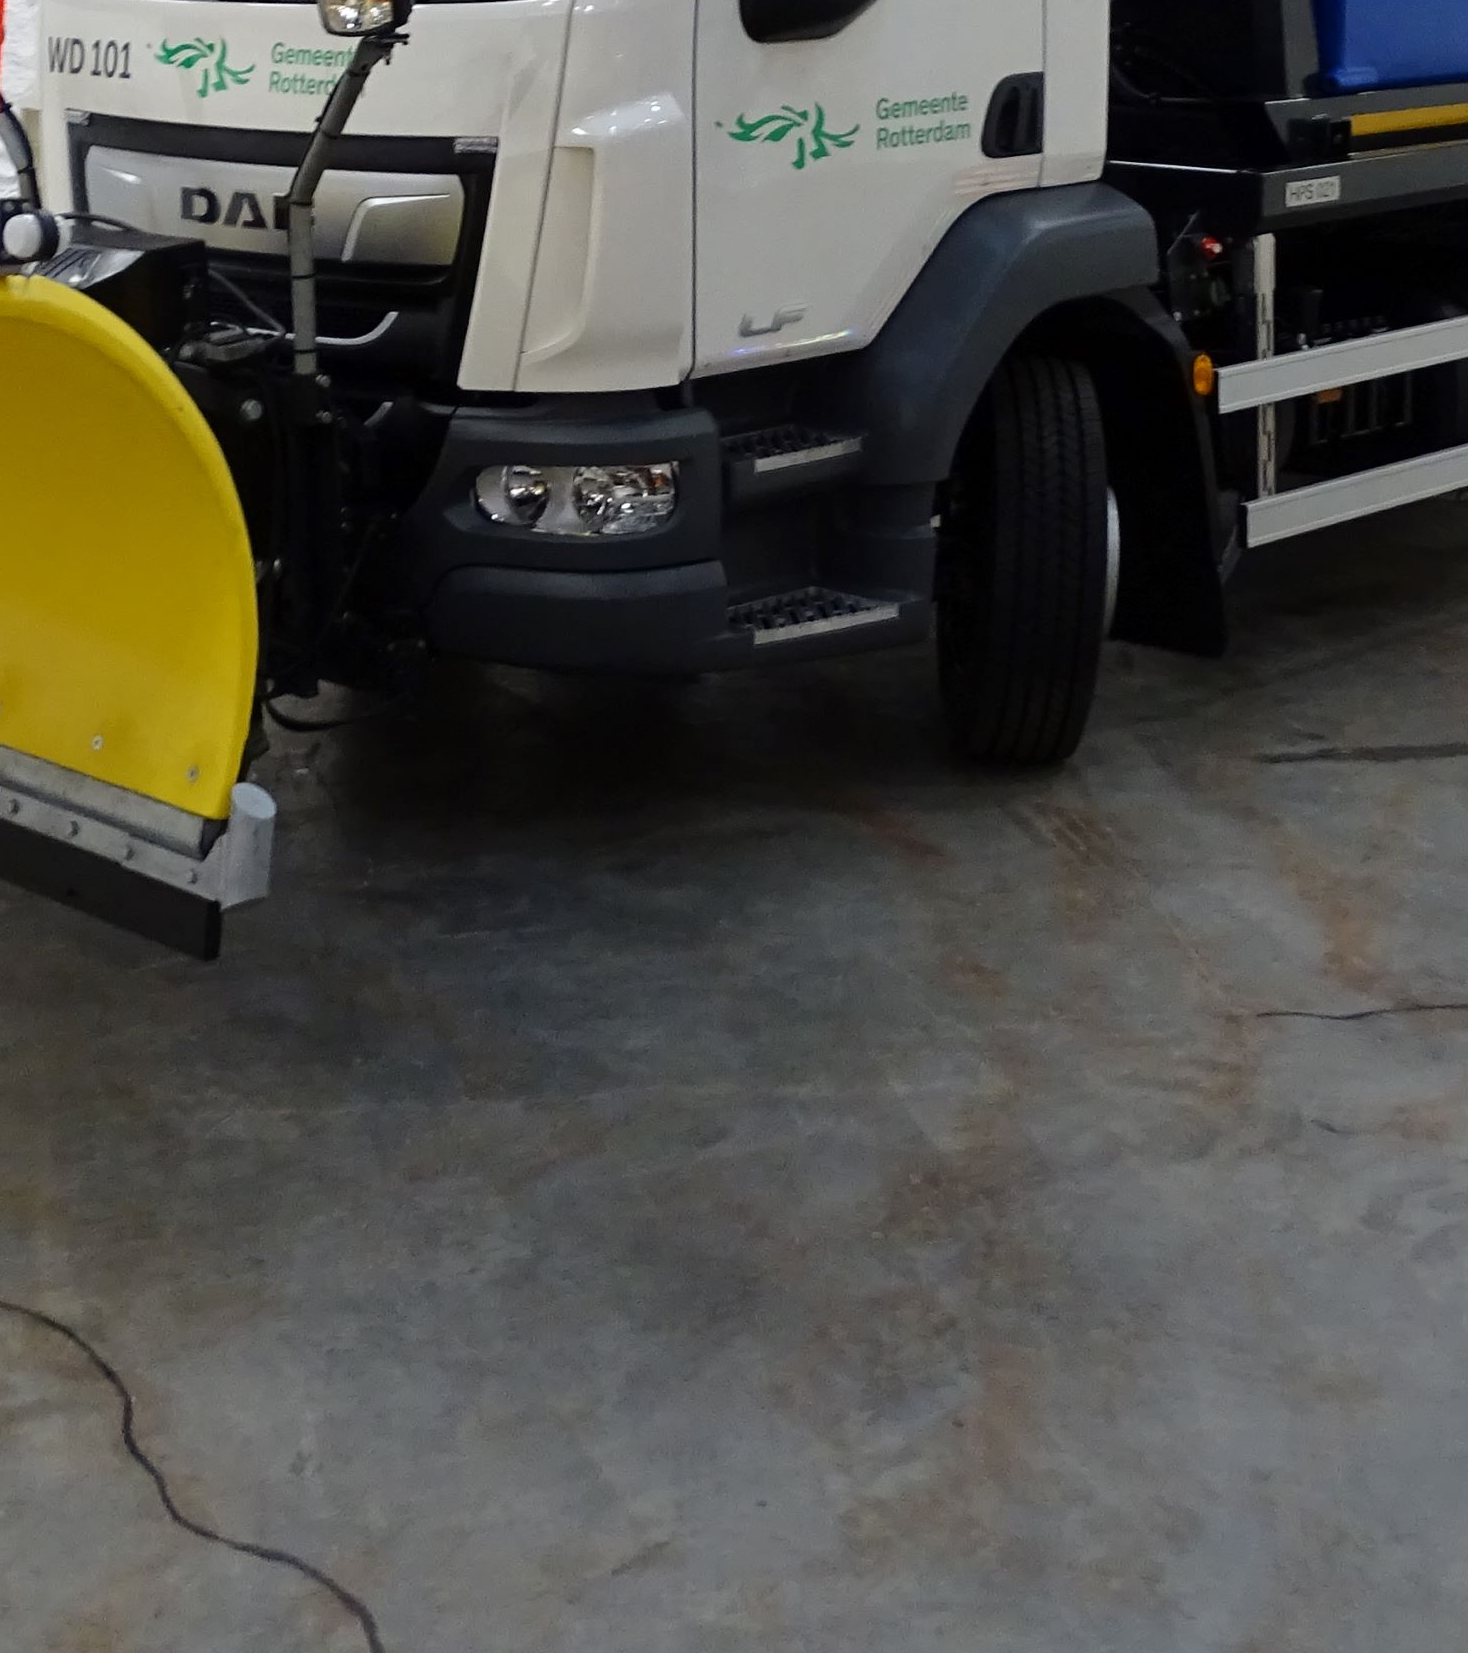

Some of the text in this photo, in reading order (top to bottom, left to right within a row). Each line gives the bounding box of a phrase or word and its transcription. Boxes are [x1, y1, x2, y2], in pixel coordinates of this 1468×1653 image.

[48, 36, 131, 78] WD 101
[271, 42, 356, 68] Gemeent
[269, 71, 339, 96] Rotterd
[876, 91, 969, 120] Gemeente
[876, 120, 971, 150] Rotterdam
[739, 303, 811, 338] LF
